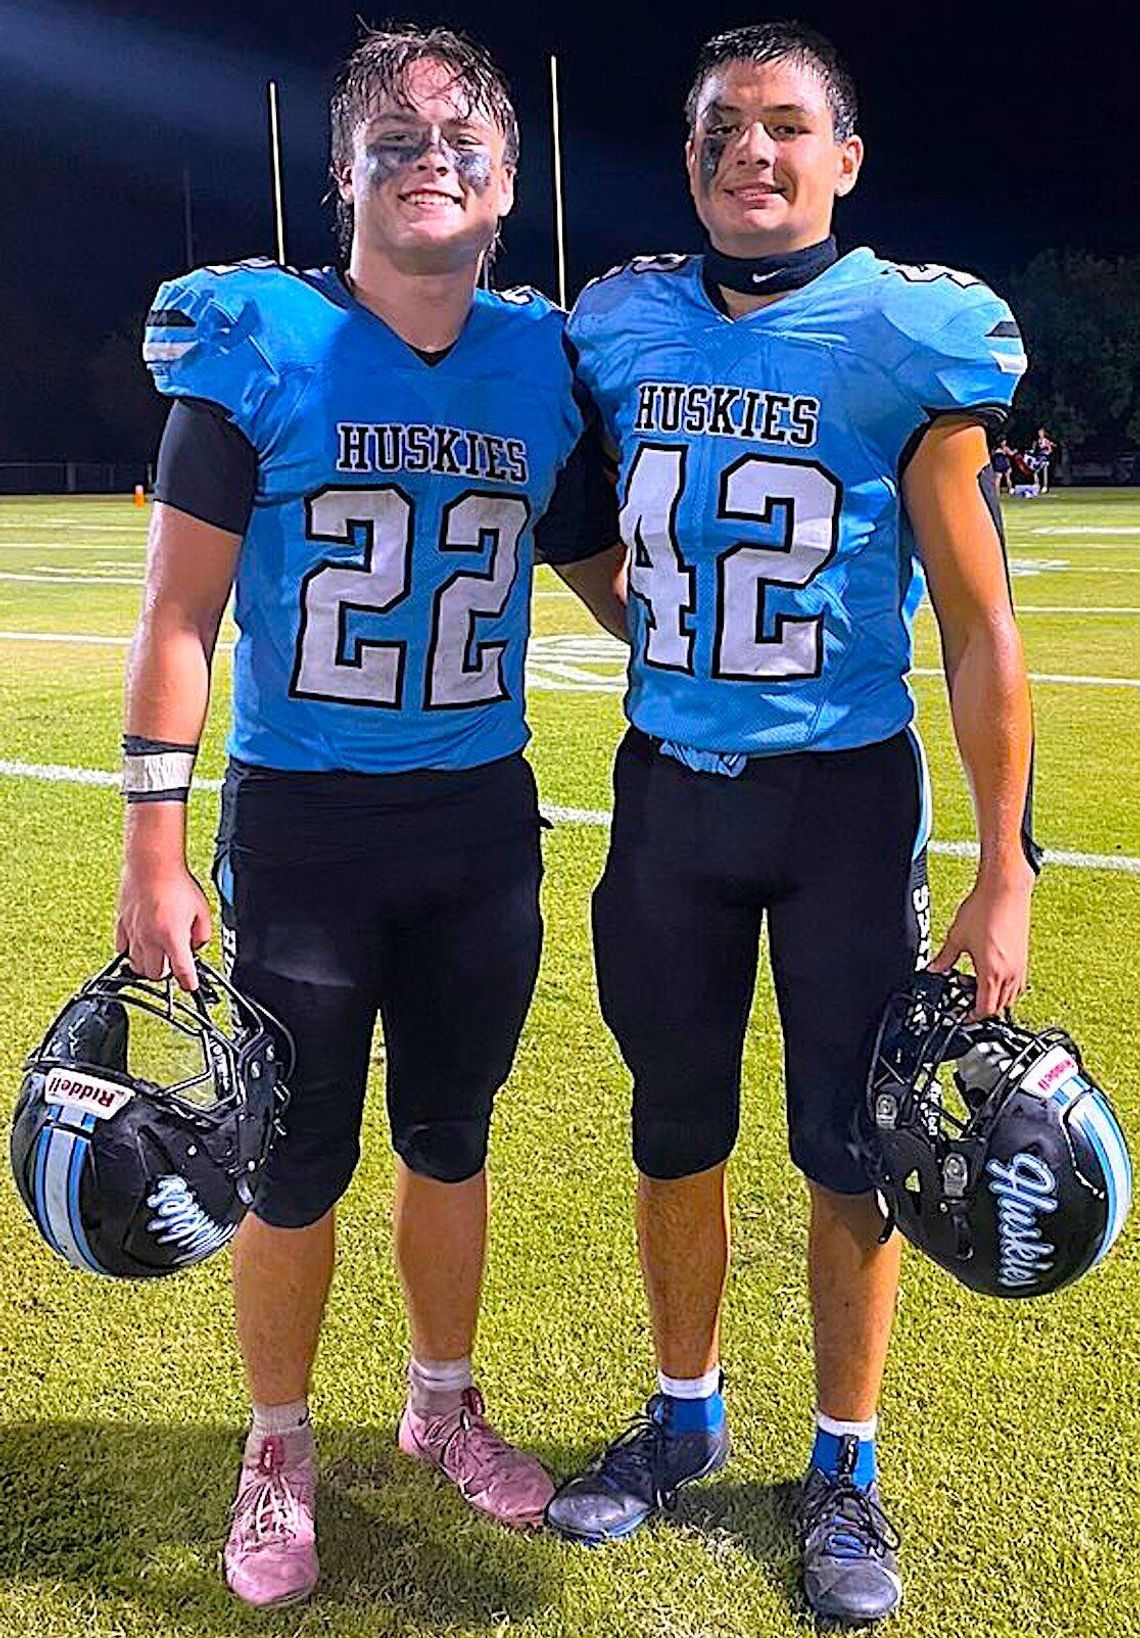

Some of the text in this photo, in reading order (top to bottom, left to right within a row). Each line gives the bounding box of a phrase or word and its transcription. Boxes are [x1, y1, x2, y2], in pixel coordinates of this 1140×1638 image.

[336, 422, 528, 484] HUSKIES
[634, 382, 821, 447] HUSKIES
[288, 482, 532, 711] 22
[617, 442, 844, 682] 42
[48, 1076, 115, 1108] Riddell
[985, 1151, 1059, 1288] Huskies
